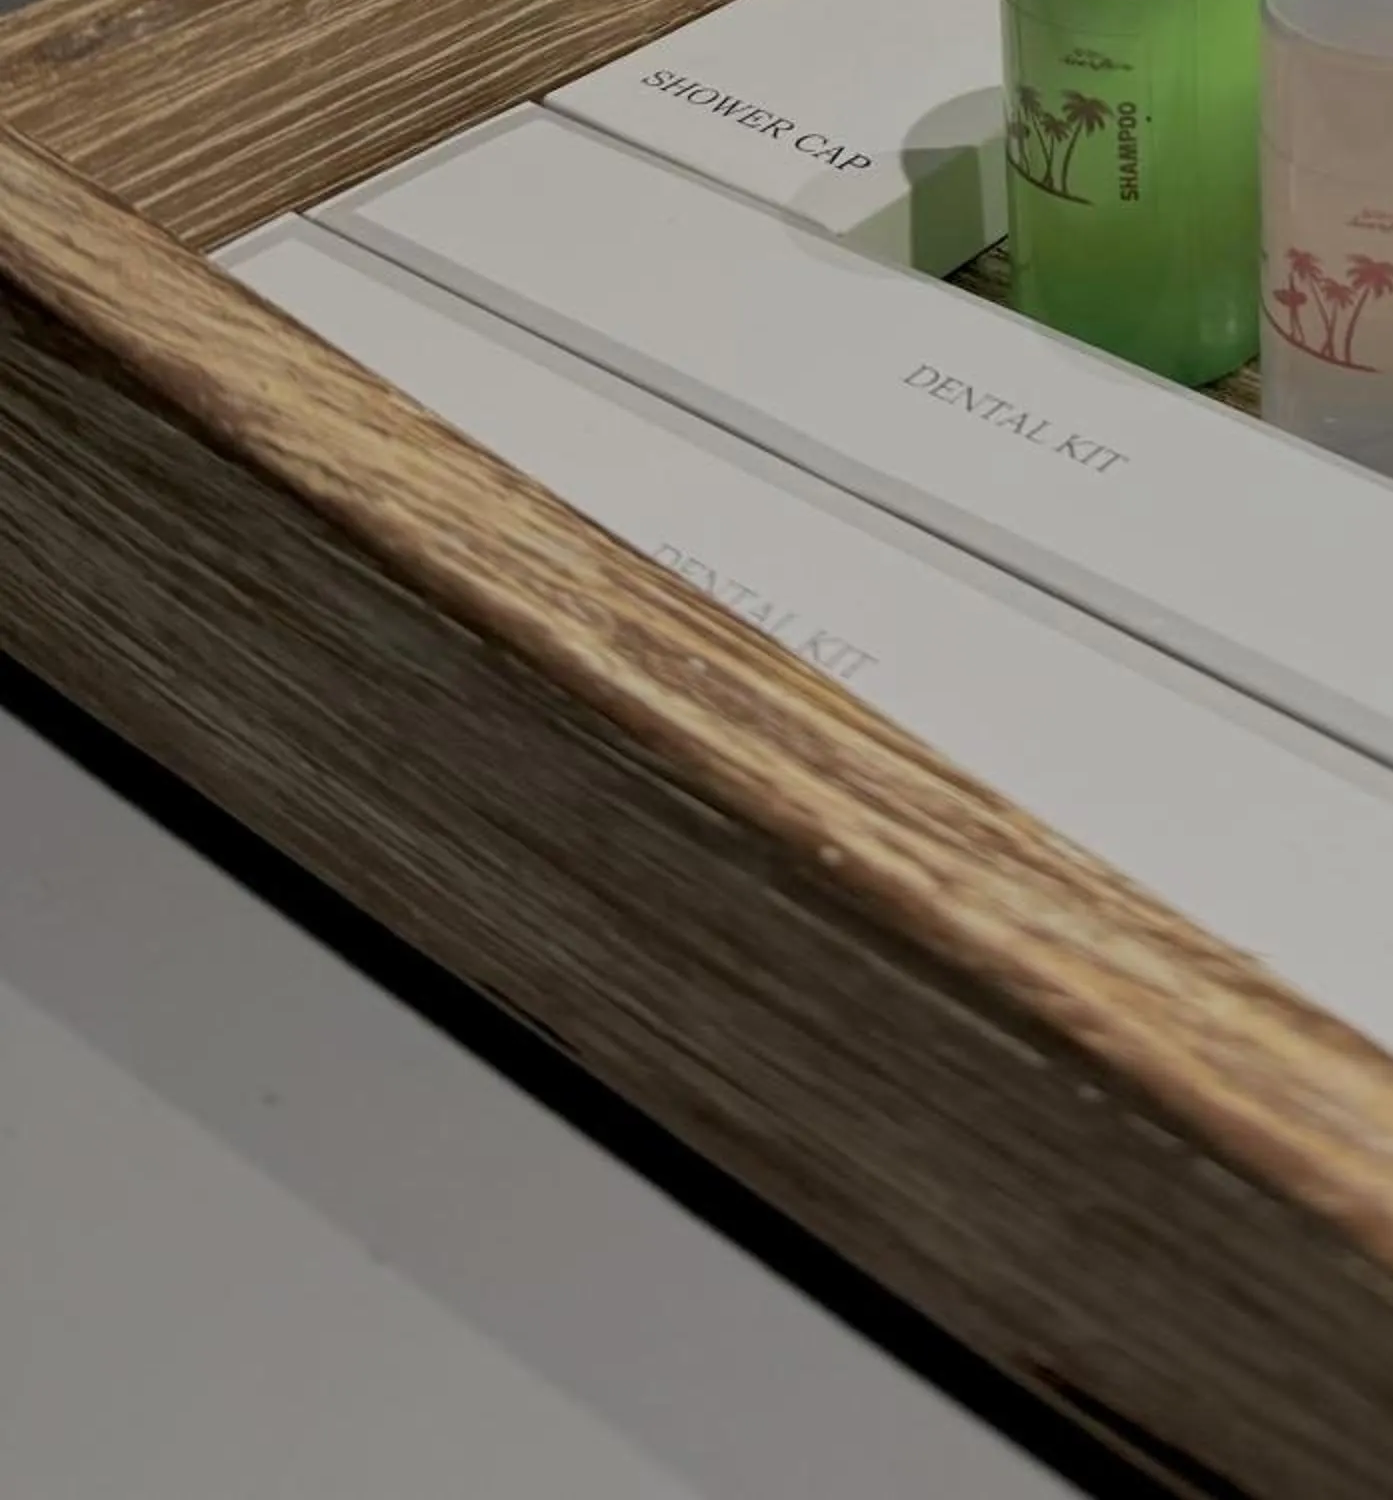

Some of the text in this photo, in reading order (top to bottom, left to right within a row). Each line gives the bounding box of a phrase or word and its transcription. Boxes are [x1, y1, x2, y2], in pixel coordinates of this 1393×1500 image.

[640, 68, 872, 171] SHOWER CAP
[1117, 101, 1139, 202] SHAMPOO
[902, 363, 1131, 473] DENTAL KIT
[799, 629, 881, 680] KIT
